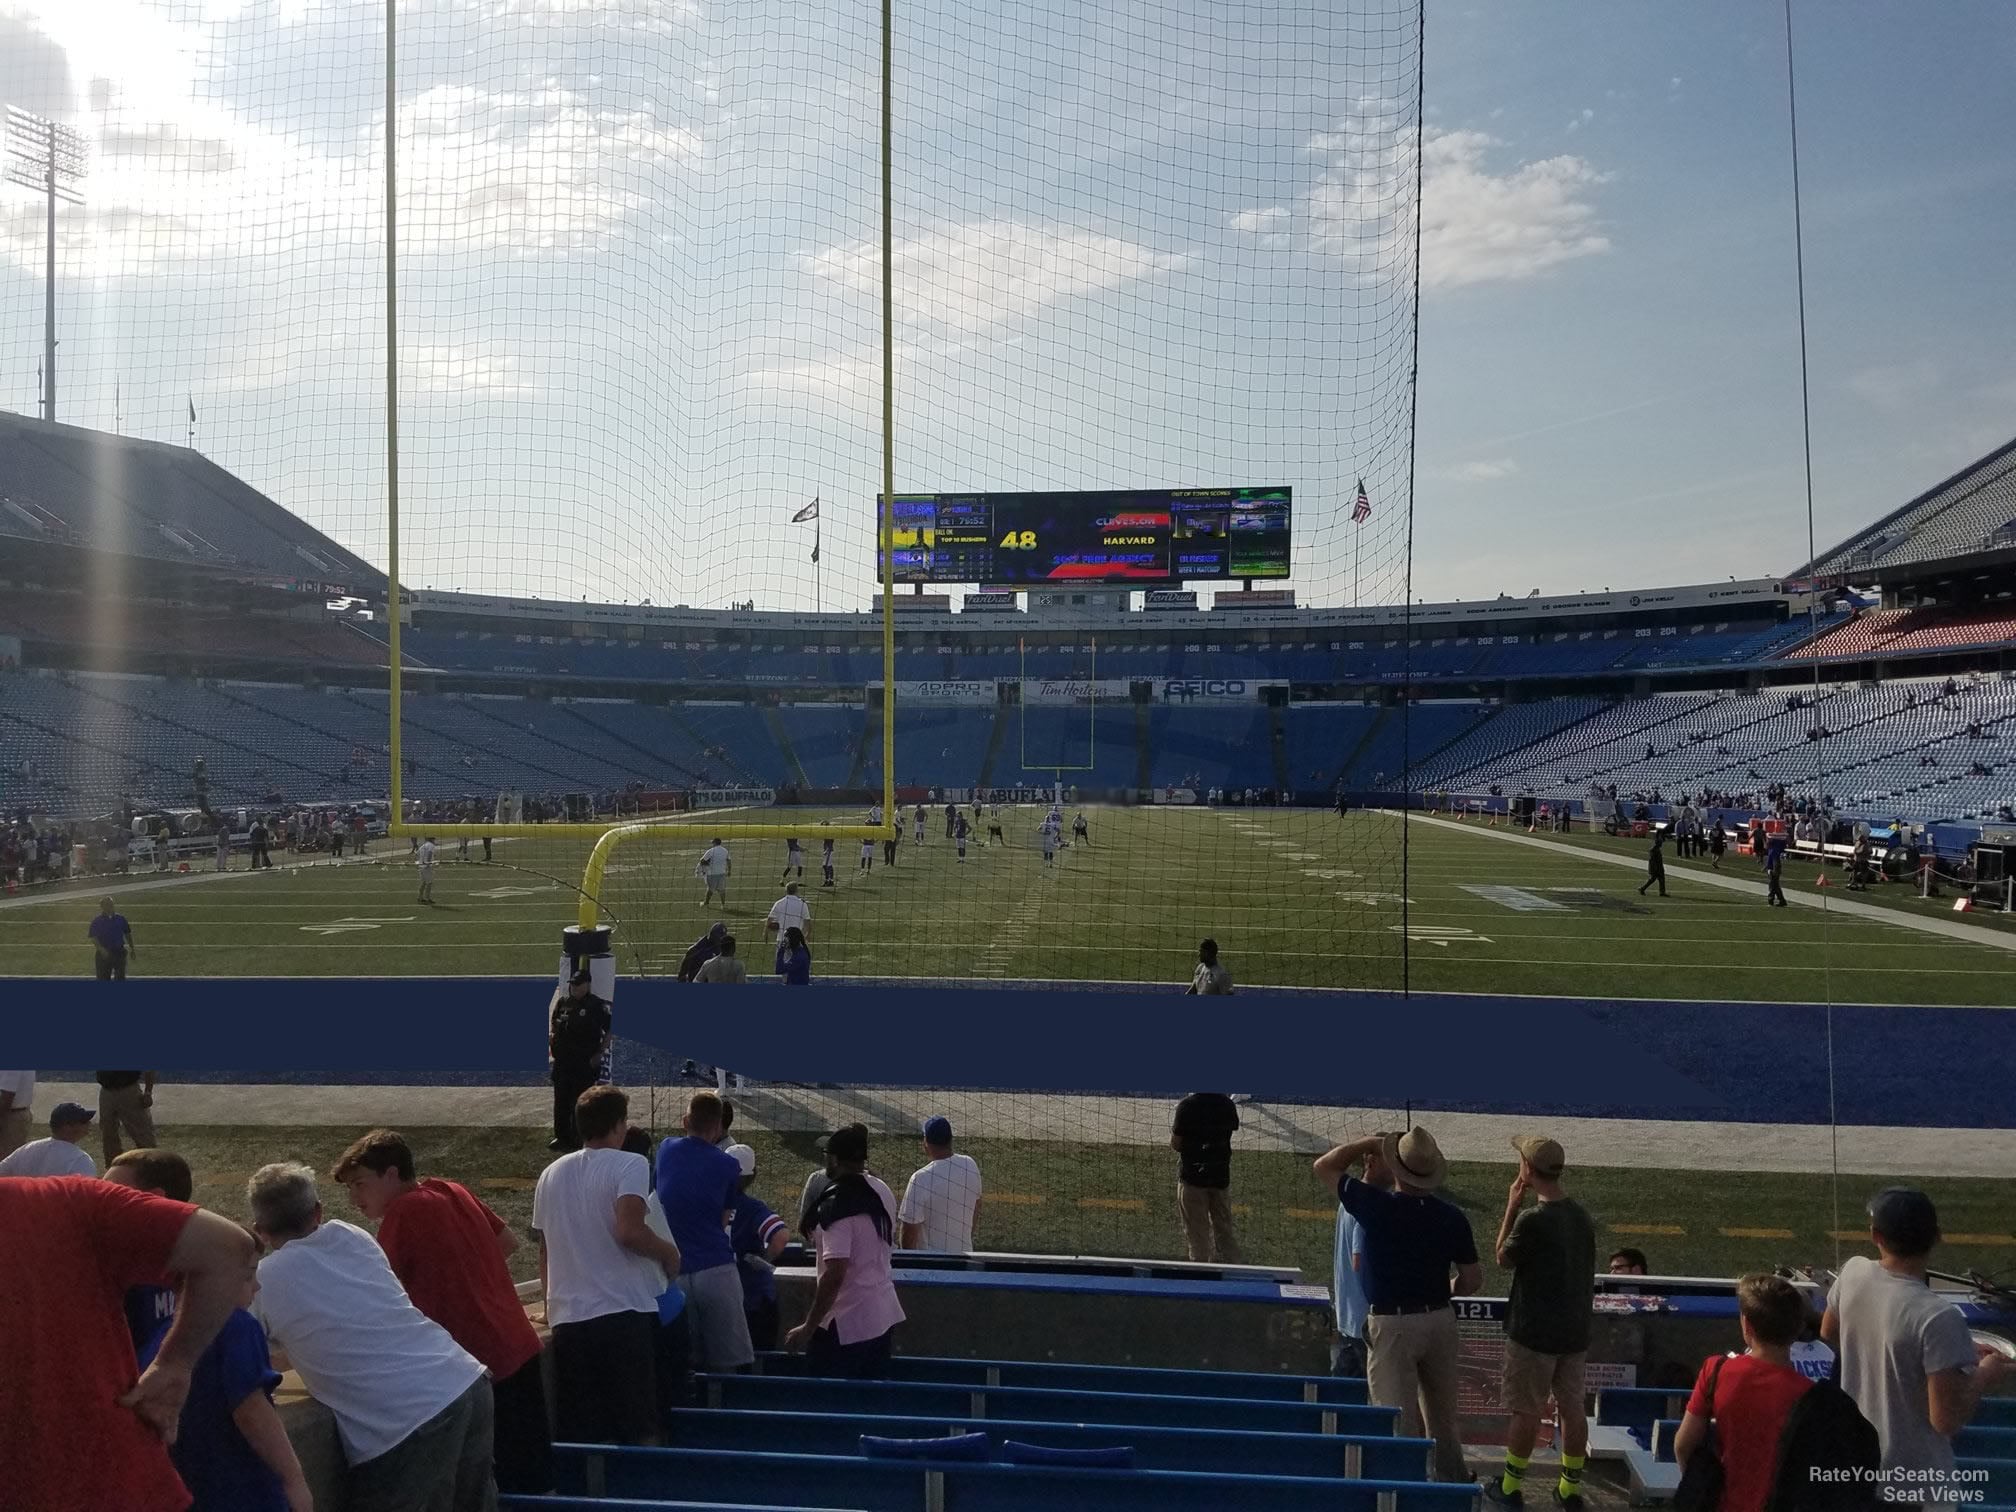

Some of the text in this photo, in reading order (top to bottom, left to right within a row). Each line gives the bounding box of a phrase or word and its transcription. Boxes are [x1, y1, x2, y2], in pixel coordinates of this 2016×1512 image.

[1000, 530, 1038, 550] 48
[1103, 537, 1155, 545] HARVARD
[1147, 592, 1194, 602] FanDuel
[1835, 603, 1851, 613] 205
[1635, 626, 1676, 637] 203 204
[1478, 636, 1518, 645] 202 203
[1040, 681, 1108, 696] Tim Hortons
[1166, 680, 1246, 696] GEICO
[711, 792, 723, 801] GO
[1457, 1302, 1494, 1319] 121
